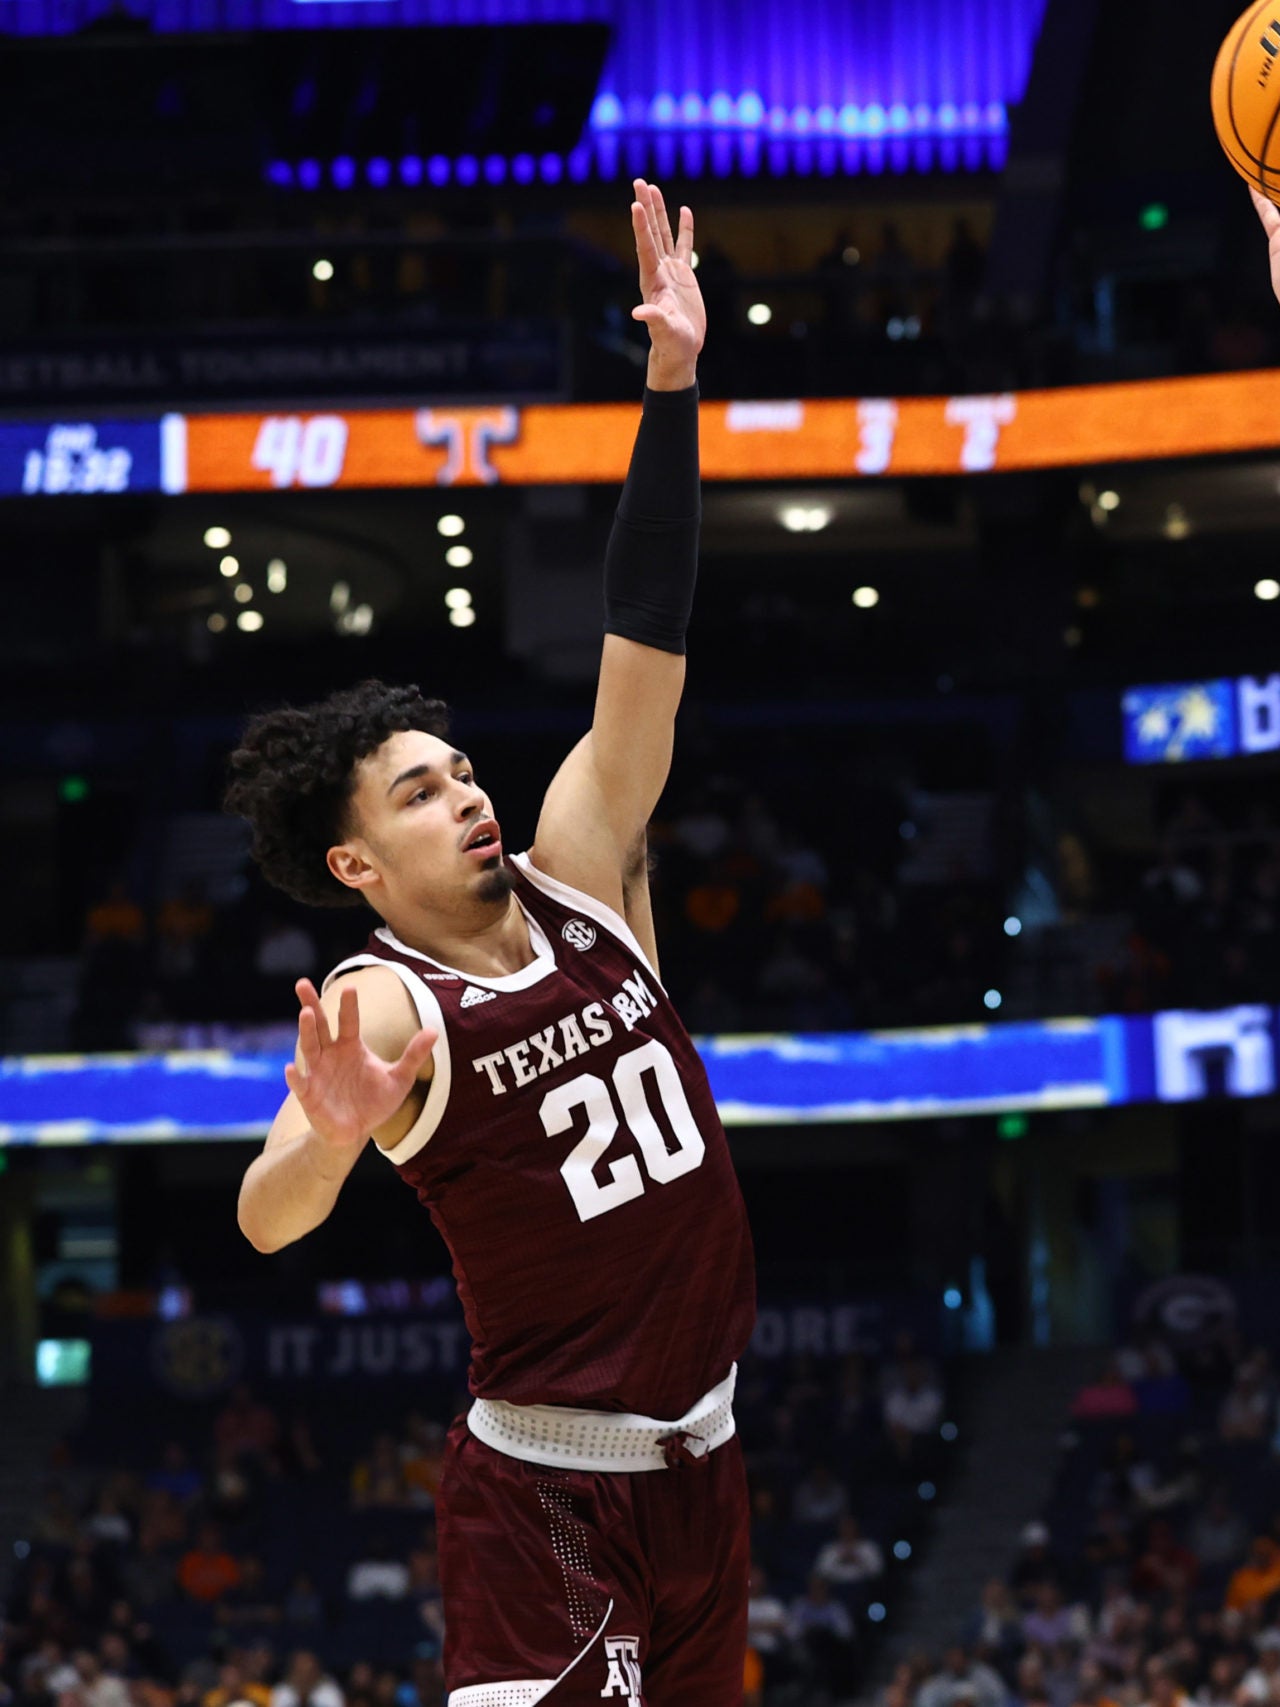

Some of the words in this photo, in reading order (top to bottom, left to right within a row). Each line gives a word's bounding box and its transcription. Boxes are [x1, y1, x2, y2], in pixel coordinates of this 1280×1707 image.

[0, 353, 167, 391] ETBALL
[251, 414, 348, 489] 40
[565, 920, 593, 949] SEC
[472, 1002, 613, 1096] TEXAS
[604, 969, 658, 1032] &M
[538, 1038, 706, 1223] 20
[268, 1326, 317, 1376] IT
[327, 1322, 463, 1377] JUST
[750, 1303, 868, 1358] ORE
